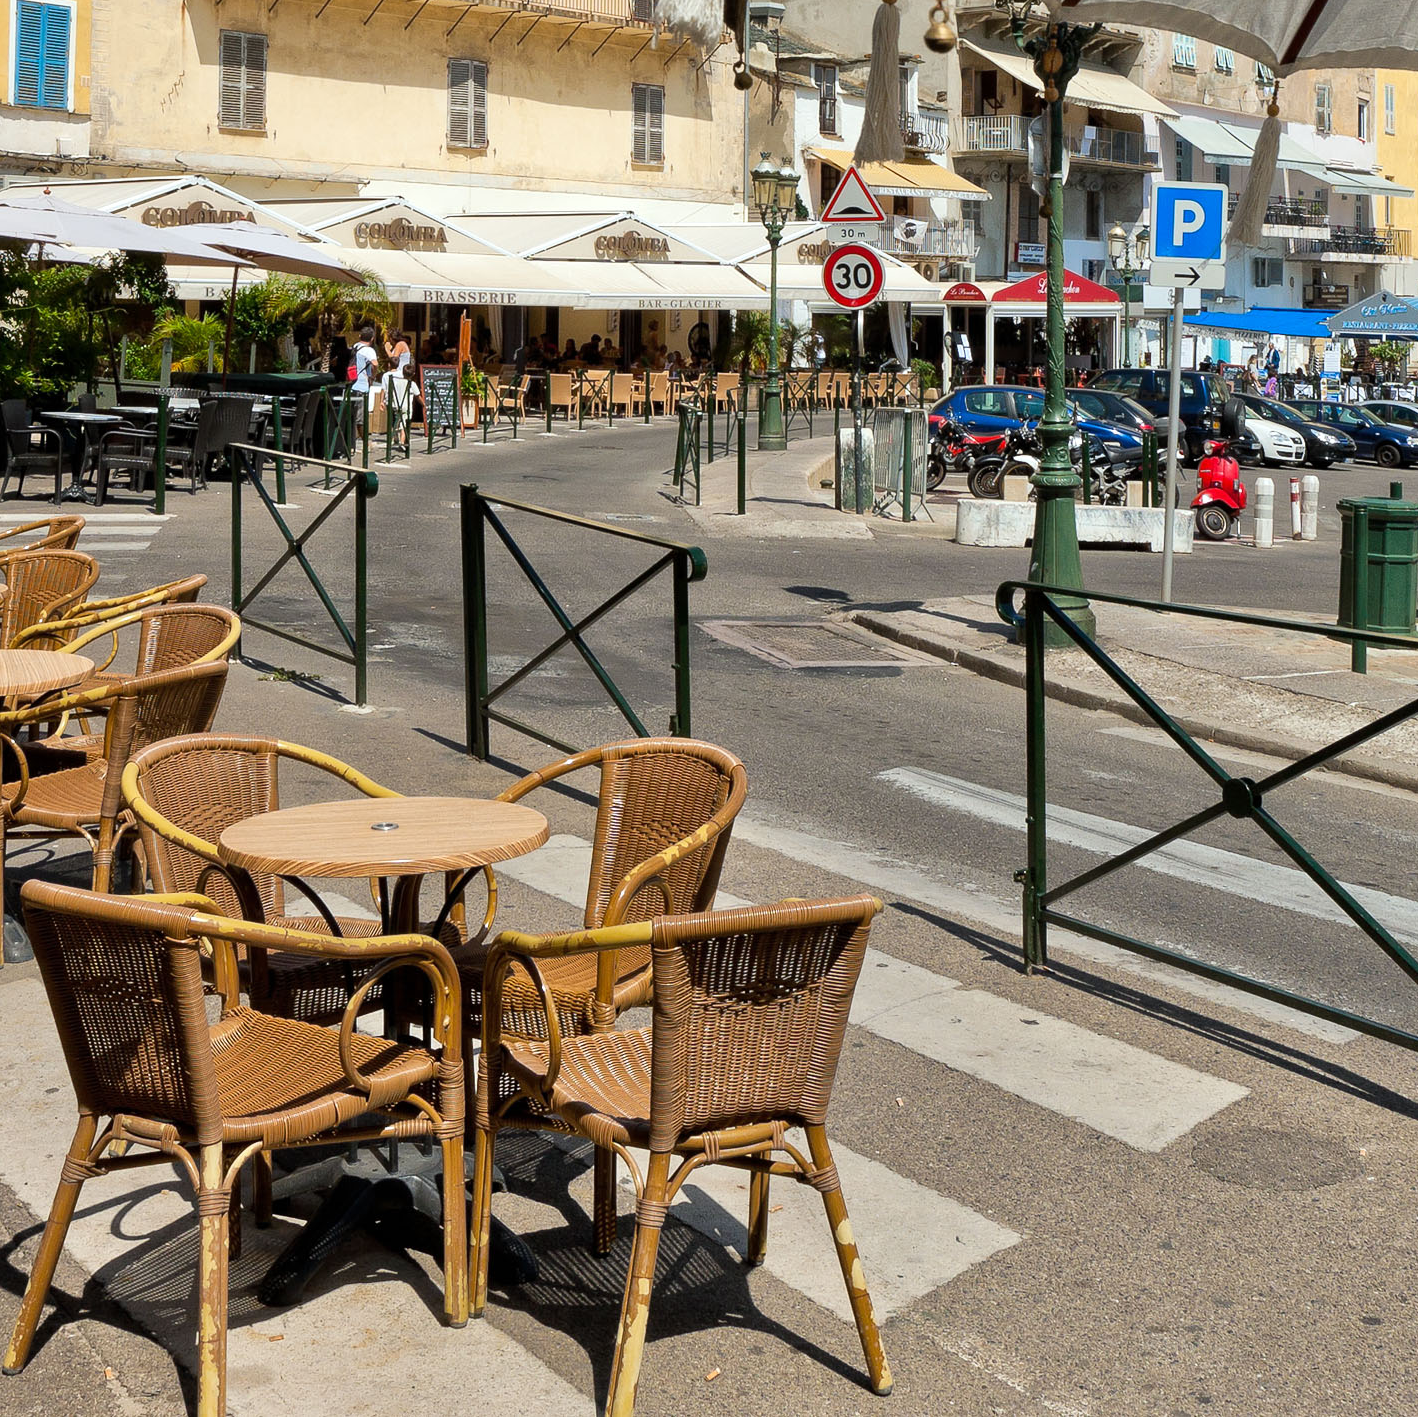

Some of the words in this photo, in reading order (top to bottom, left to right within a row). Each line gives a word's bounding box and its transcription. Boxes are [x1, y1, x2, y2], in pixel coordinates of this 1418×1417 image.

[355, 218, 449, 247] COLOMBA
[841, 229, 854, 238] 30
[1173, 200, 1205, 246] P
[595, 230, 671, 259] COLOMBA
[835, 263, 871, 289] 30
[423, 290, 517, 304] BRASSERIE
[1342, 321, 1389, 330] RESTAURANT
